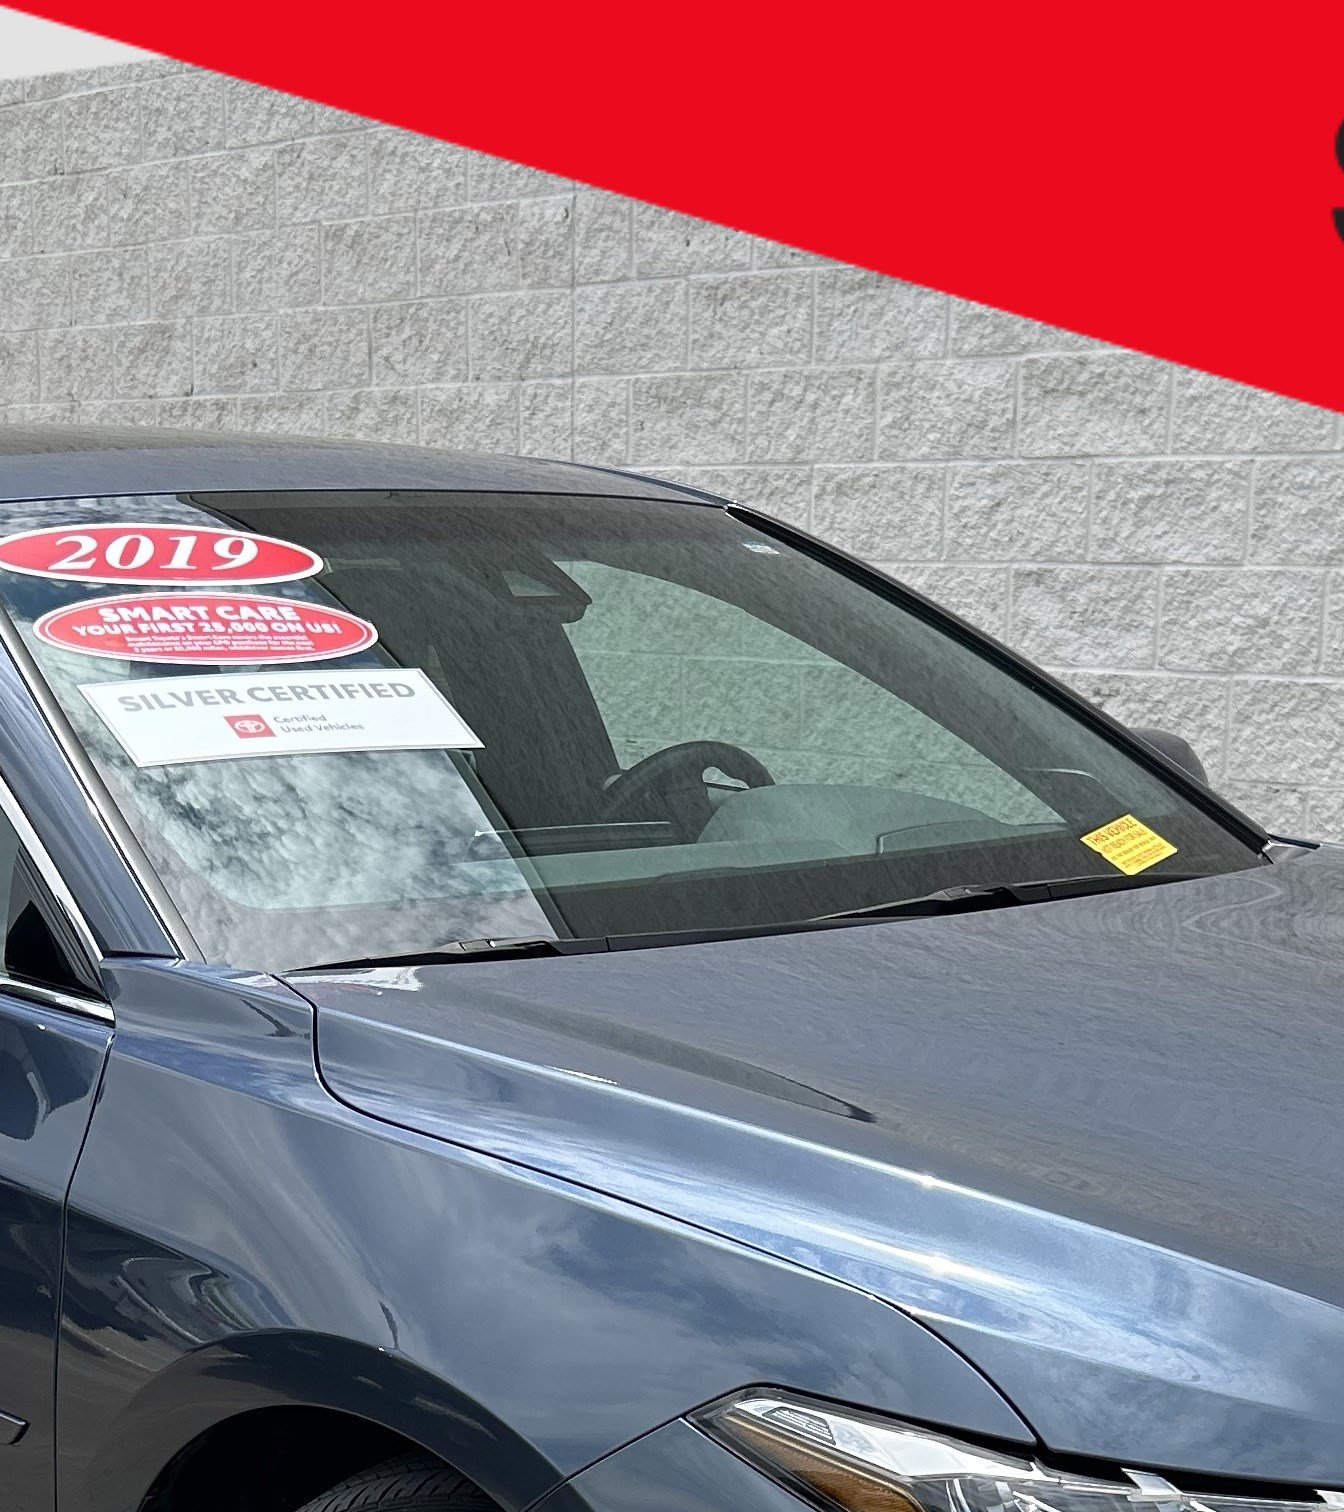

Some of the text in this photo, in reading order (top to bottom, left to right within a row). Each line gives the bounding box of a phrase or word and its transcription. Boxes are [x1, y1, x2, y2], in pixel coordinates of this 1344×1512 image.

[48, 534, 259, 571] 2019
[98, 605, 301, 622] SMART CARE
[72, 623, 138, 636] YOUR
[138, 622, 195, 634] FIRST
[270, 622, 306, 633] ON
[305, 622, 343, 635] US!
[118, 682, 416, 712] SILVER CERTIFIED
[273, 714, 327, 723] Certified
[280, 722, 364, 733] Used Vehicles
